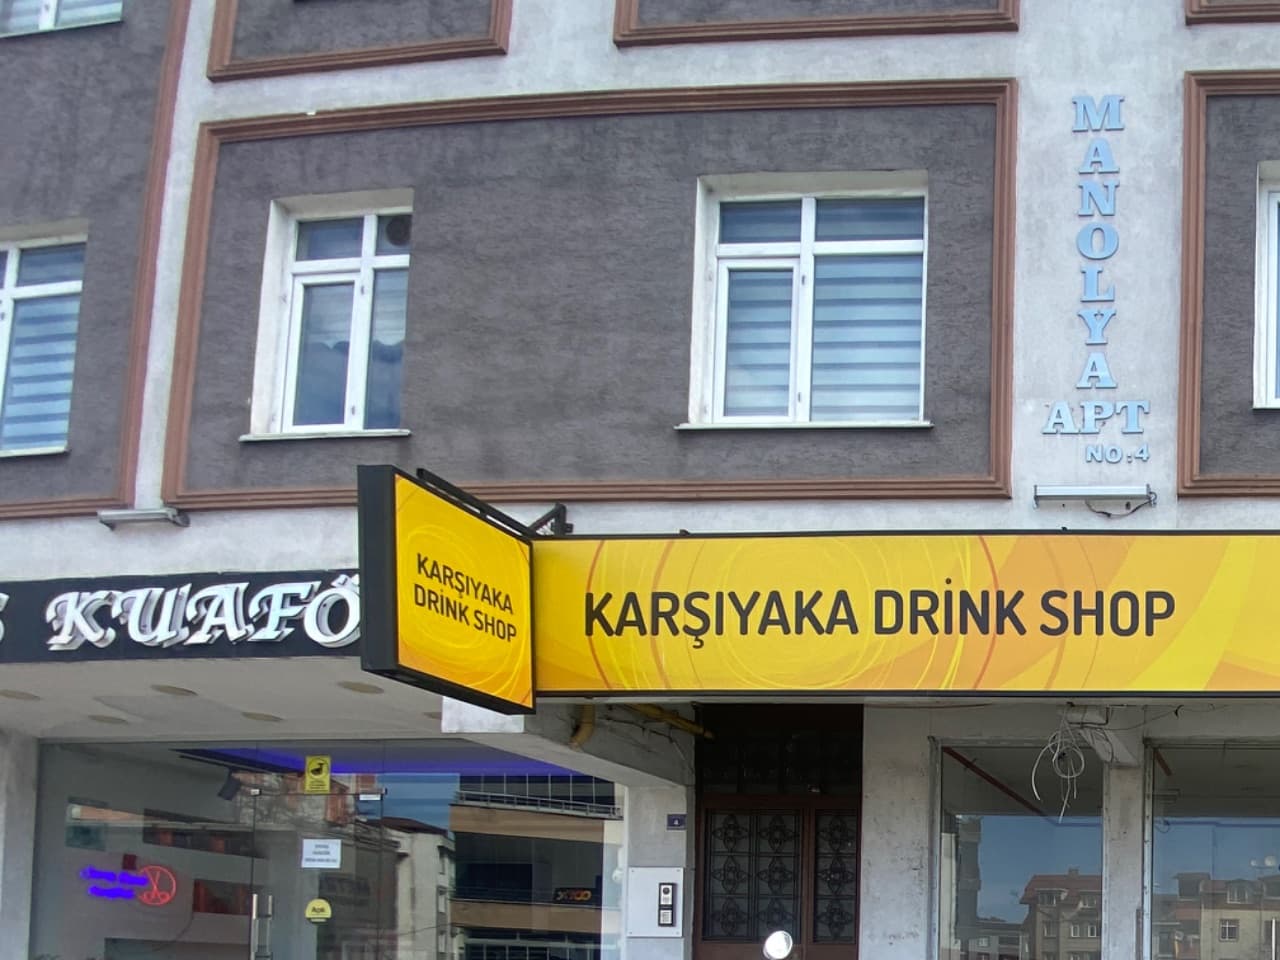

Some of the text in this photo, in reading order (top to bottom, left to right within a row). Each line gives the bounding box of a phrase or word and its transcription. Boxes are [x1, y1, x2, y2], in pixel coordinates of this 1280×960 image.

[1071, 94, 1125, 388] MANOLYA
[1042, 400, 1149, 434] APT
[417, 552, 513, 615] KARŞIYAKA
[584, 577, 1175, 649] KARŞIYAKA DRİNK SHOP
[474, 609, 517, 642] SHOP
